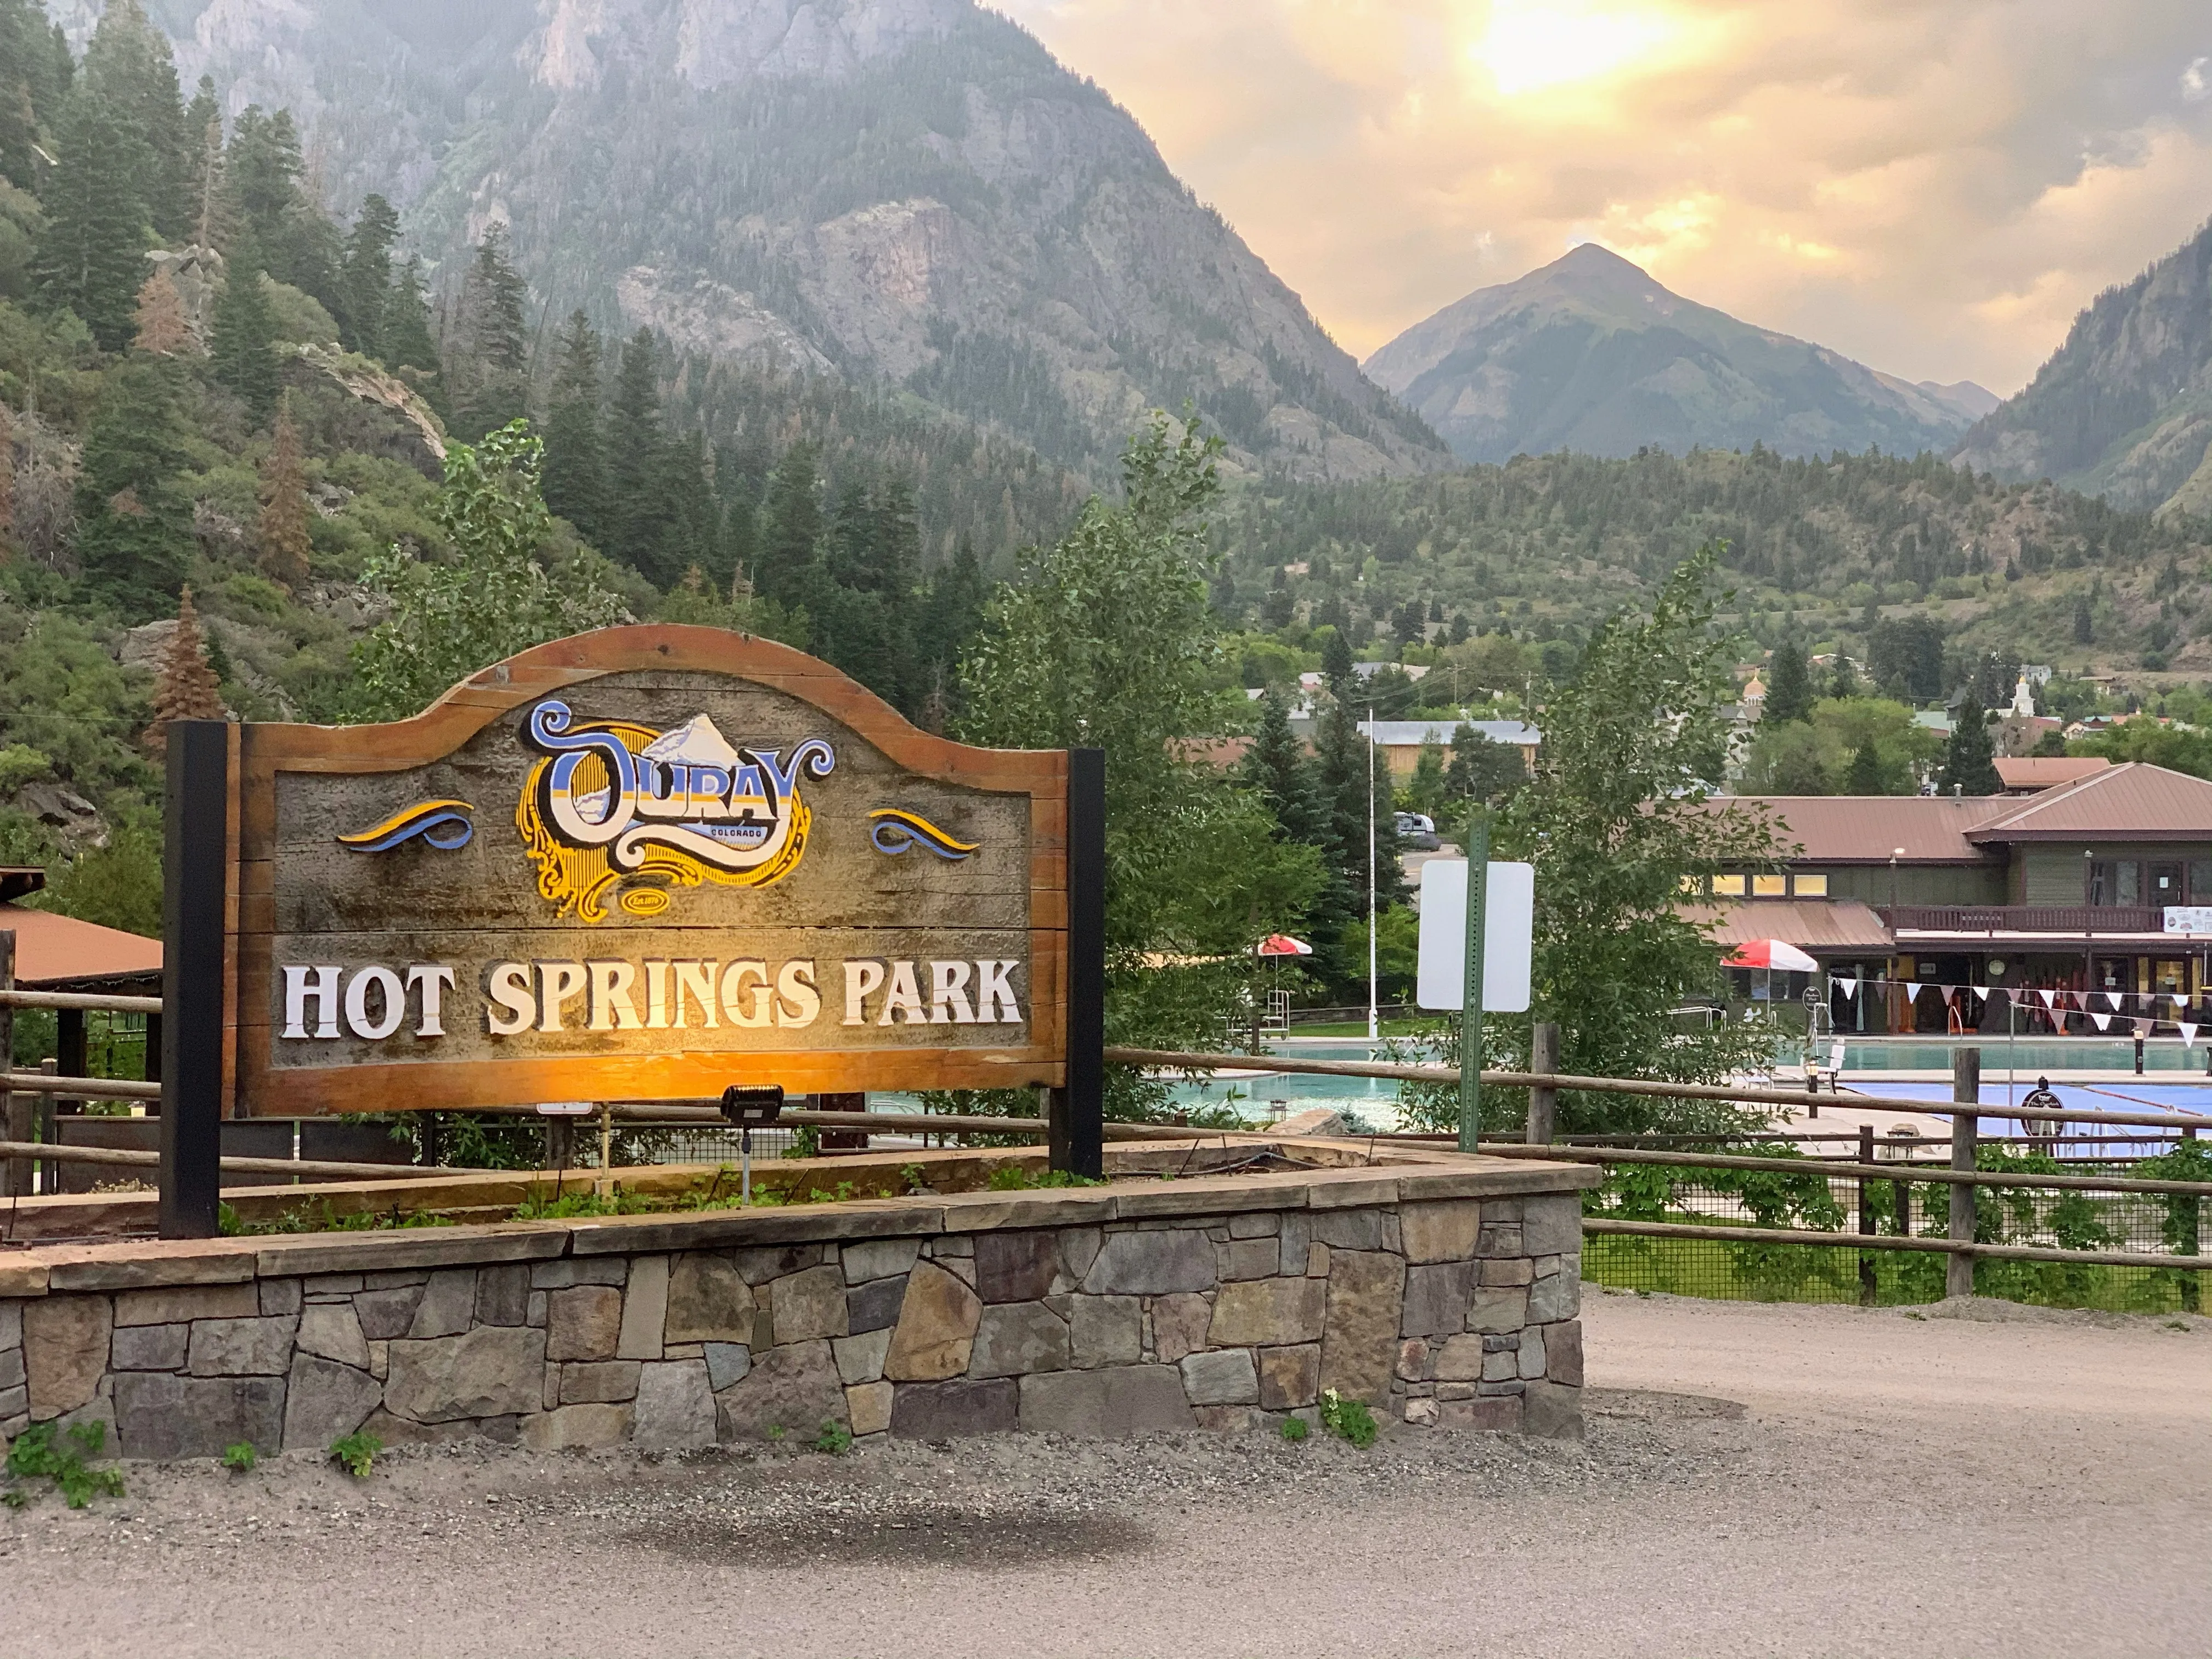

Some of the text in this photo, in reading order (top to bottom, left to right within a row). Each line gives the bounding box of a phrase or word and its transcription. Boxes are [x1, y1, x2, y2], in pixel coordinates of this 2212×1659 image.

[531, 701, 836, 867] OURAY
[711, 829, 761, 837] COLORADO
[644, 896, 659, 905] 1876
[281, 960, 1024, 1040] HOT SPRINGS PARK
